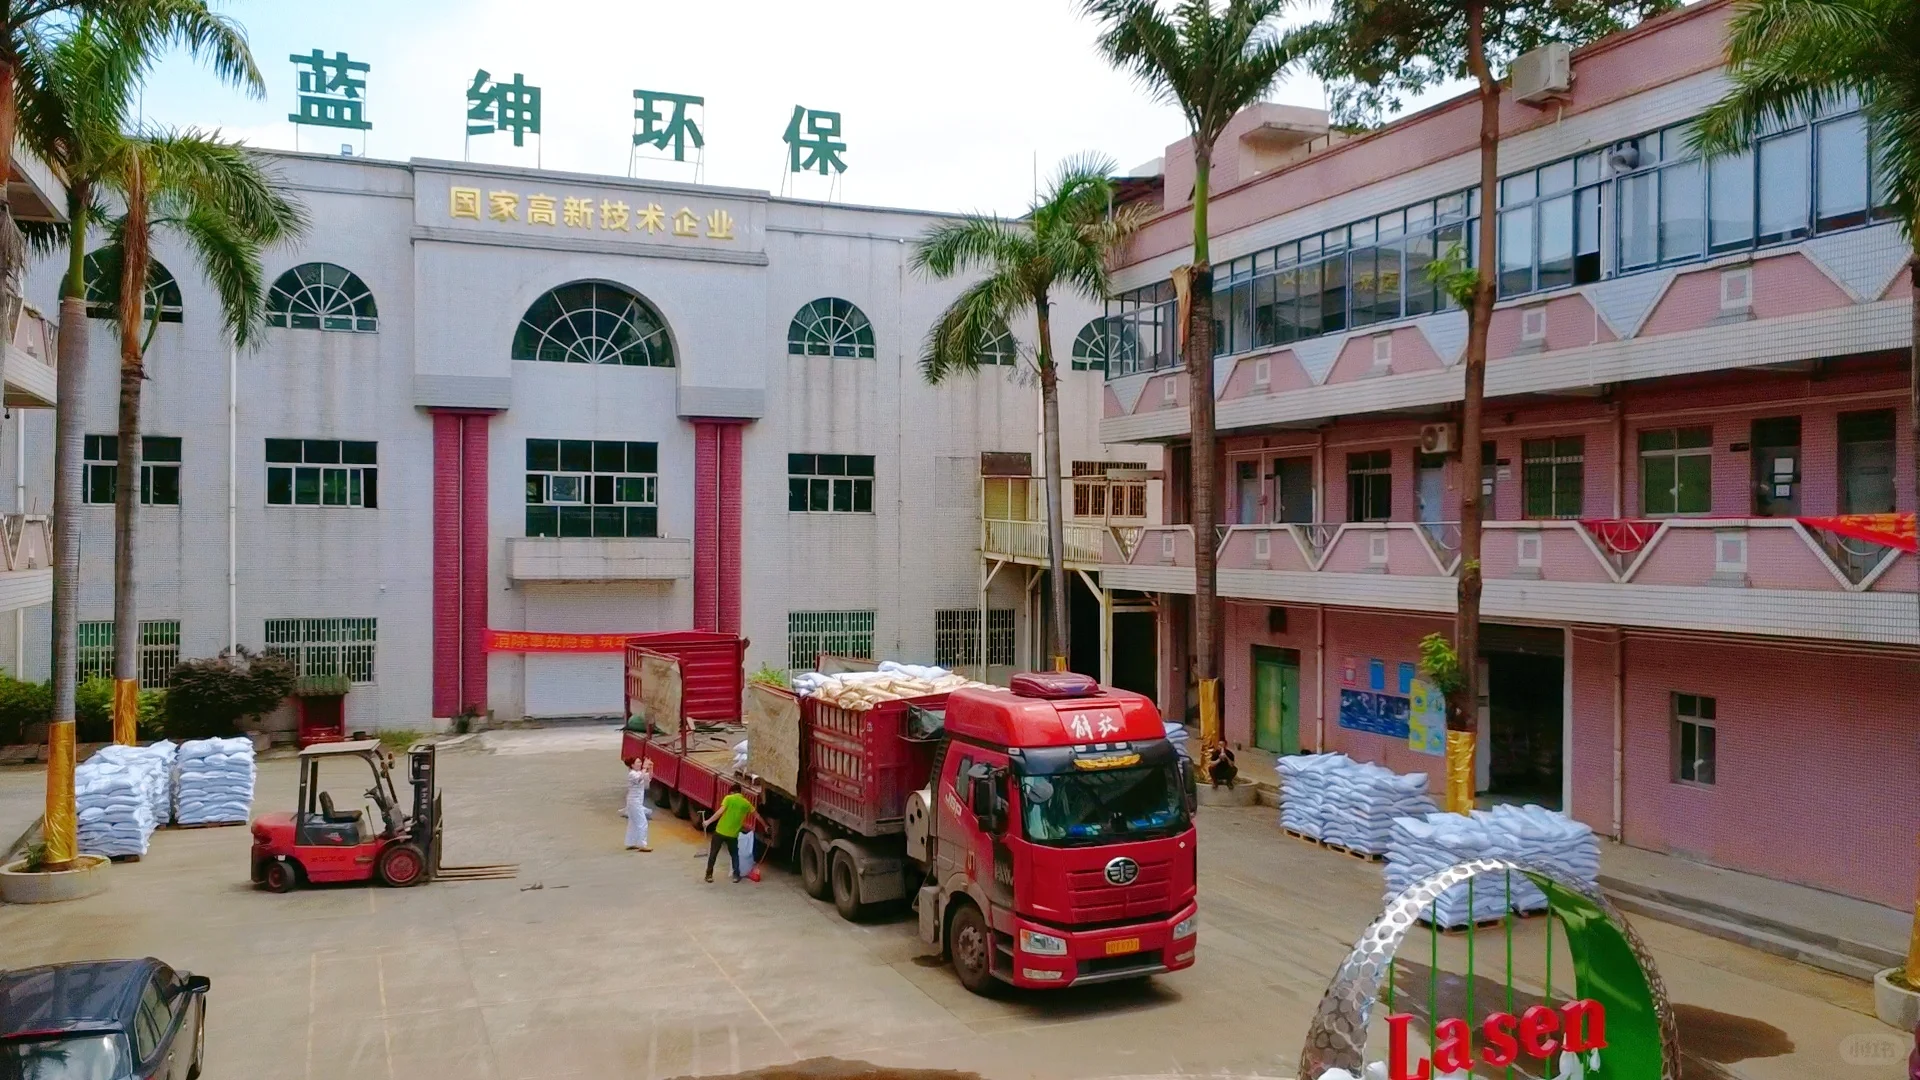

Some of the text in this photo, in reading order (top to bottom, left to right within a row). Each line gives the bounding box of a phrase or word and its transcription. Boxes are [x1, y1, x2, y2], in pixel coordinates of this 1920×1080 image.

[289, 48, 848, 175] 蓝绅环保
[450, 186, 735, 239] 国家高新技术企业
[1384, 999, 1607, 1080] Lasen
